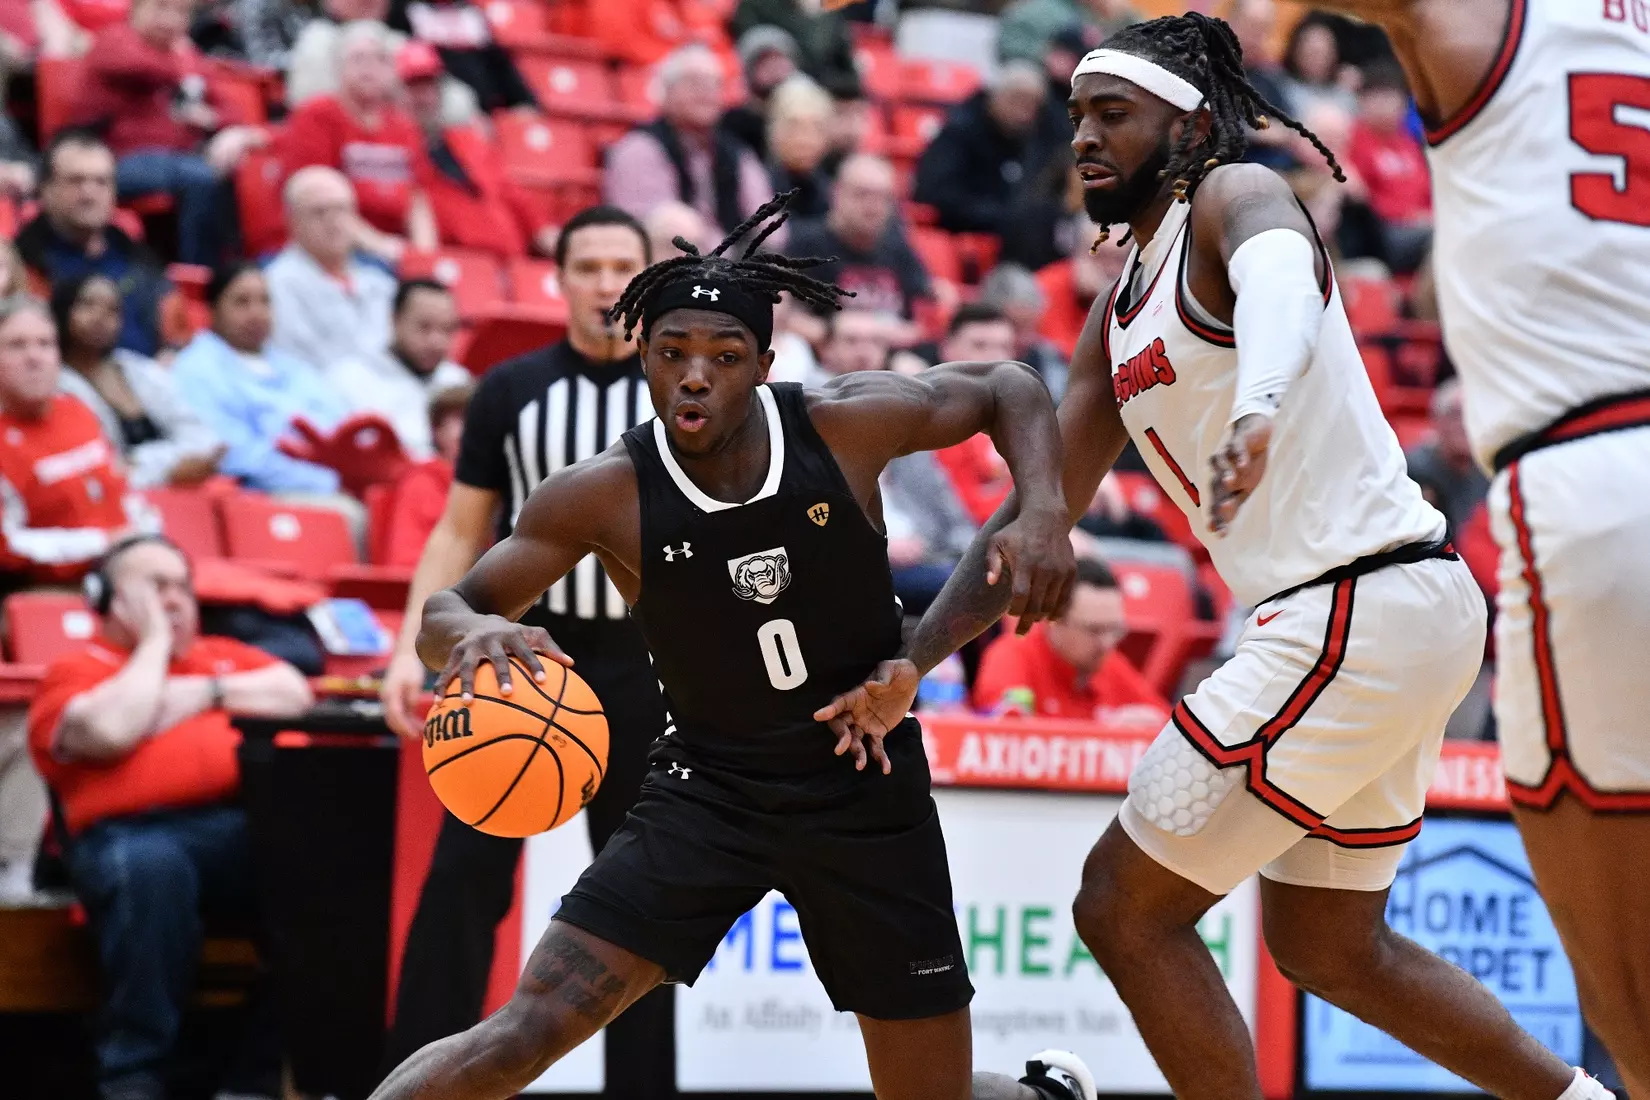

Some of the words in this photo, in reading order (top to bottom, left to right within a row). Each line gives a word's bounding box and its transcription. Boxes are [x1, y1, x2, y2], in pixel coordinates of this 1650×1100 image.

[1144, 426, 1200, 507] 1
[757, 619, 808, 691] 0
[1387, 890, 1531, 938] HOME
